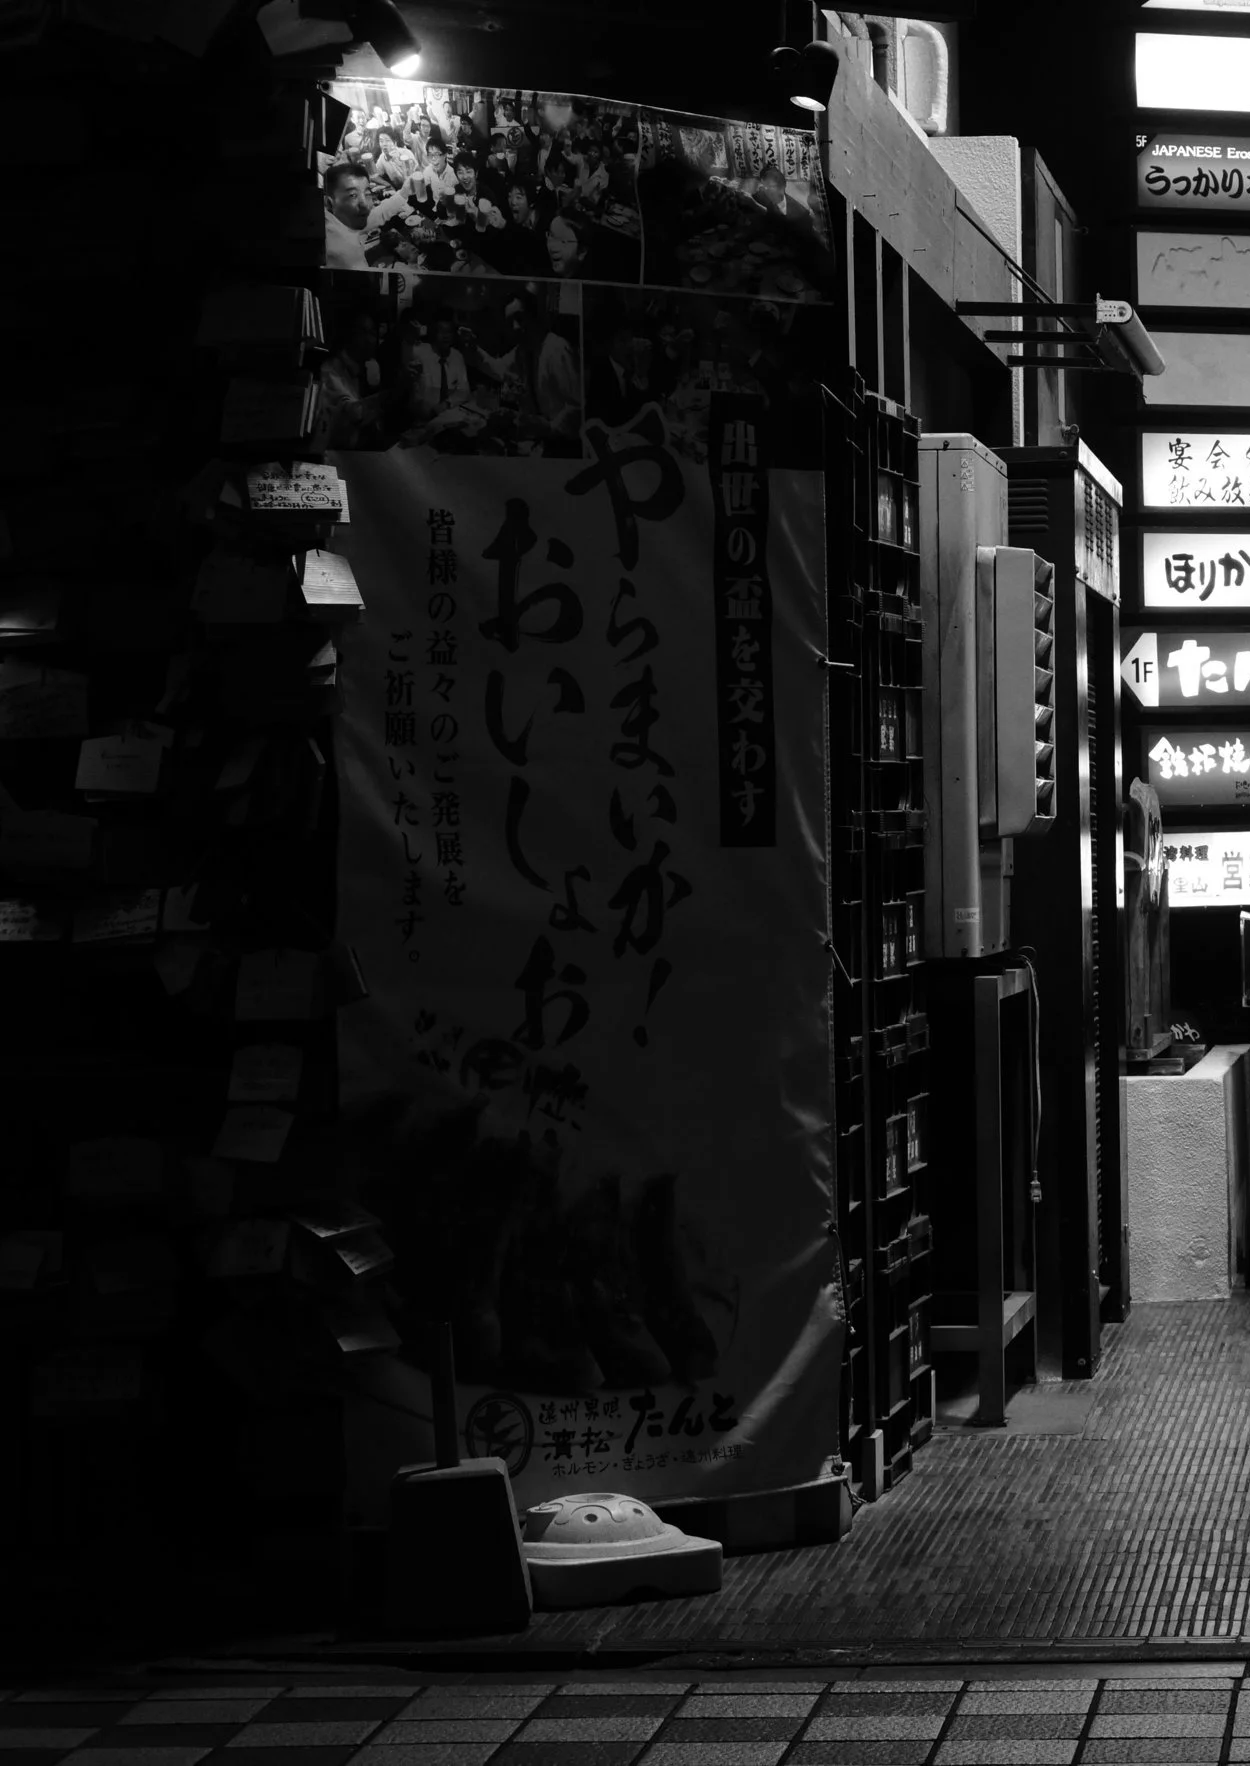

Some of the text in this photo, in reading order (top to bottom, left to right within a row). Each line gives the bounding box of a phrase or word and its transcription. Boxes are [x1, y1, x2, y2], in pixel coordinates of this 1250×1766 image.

[1135, 134, 1148, 148] 5F
[1151, 144, 1222, 158] JAPANESE
[719, 419, 769, 828] 出世の盃を交わす
[1130, 657, 1154, 684] 1F
[426, 508, 467, 908] 皆様の益々のご発展を
[384, 630, 425, 963] ご祈願いたします。
[624, 1388, 739, 1455] たんと
